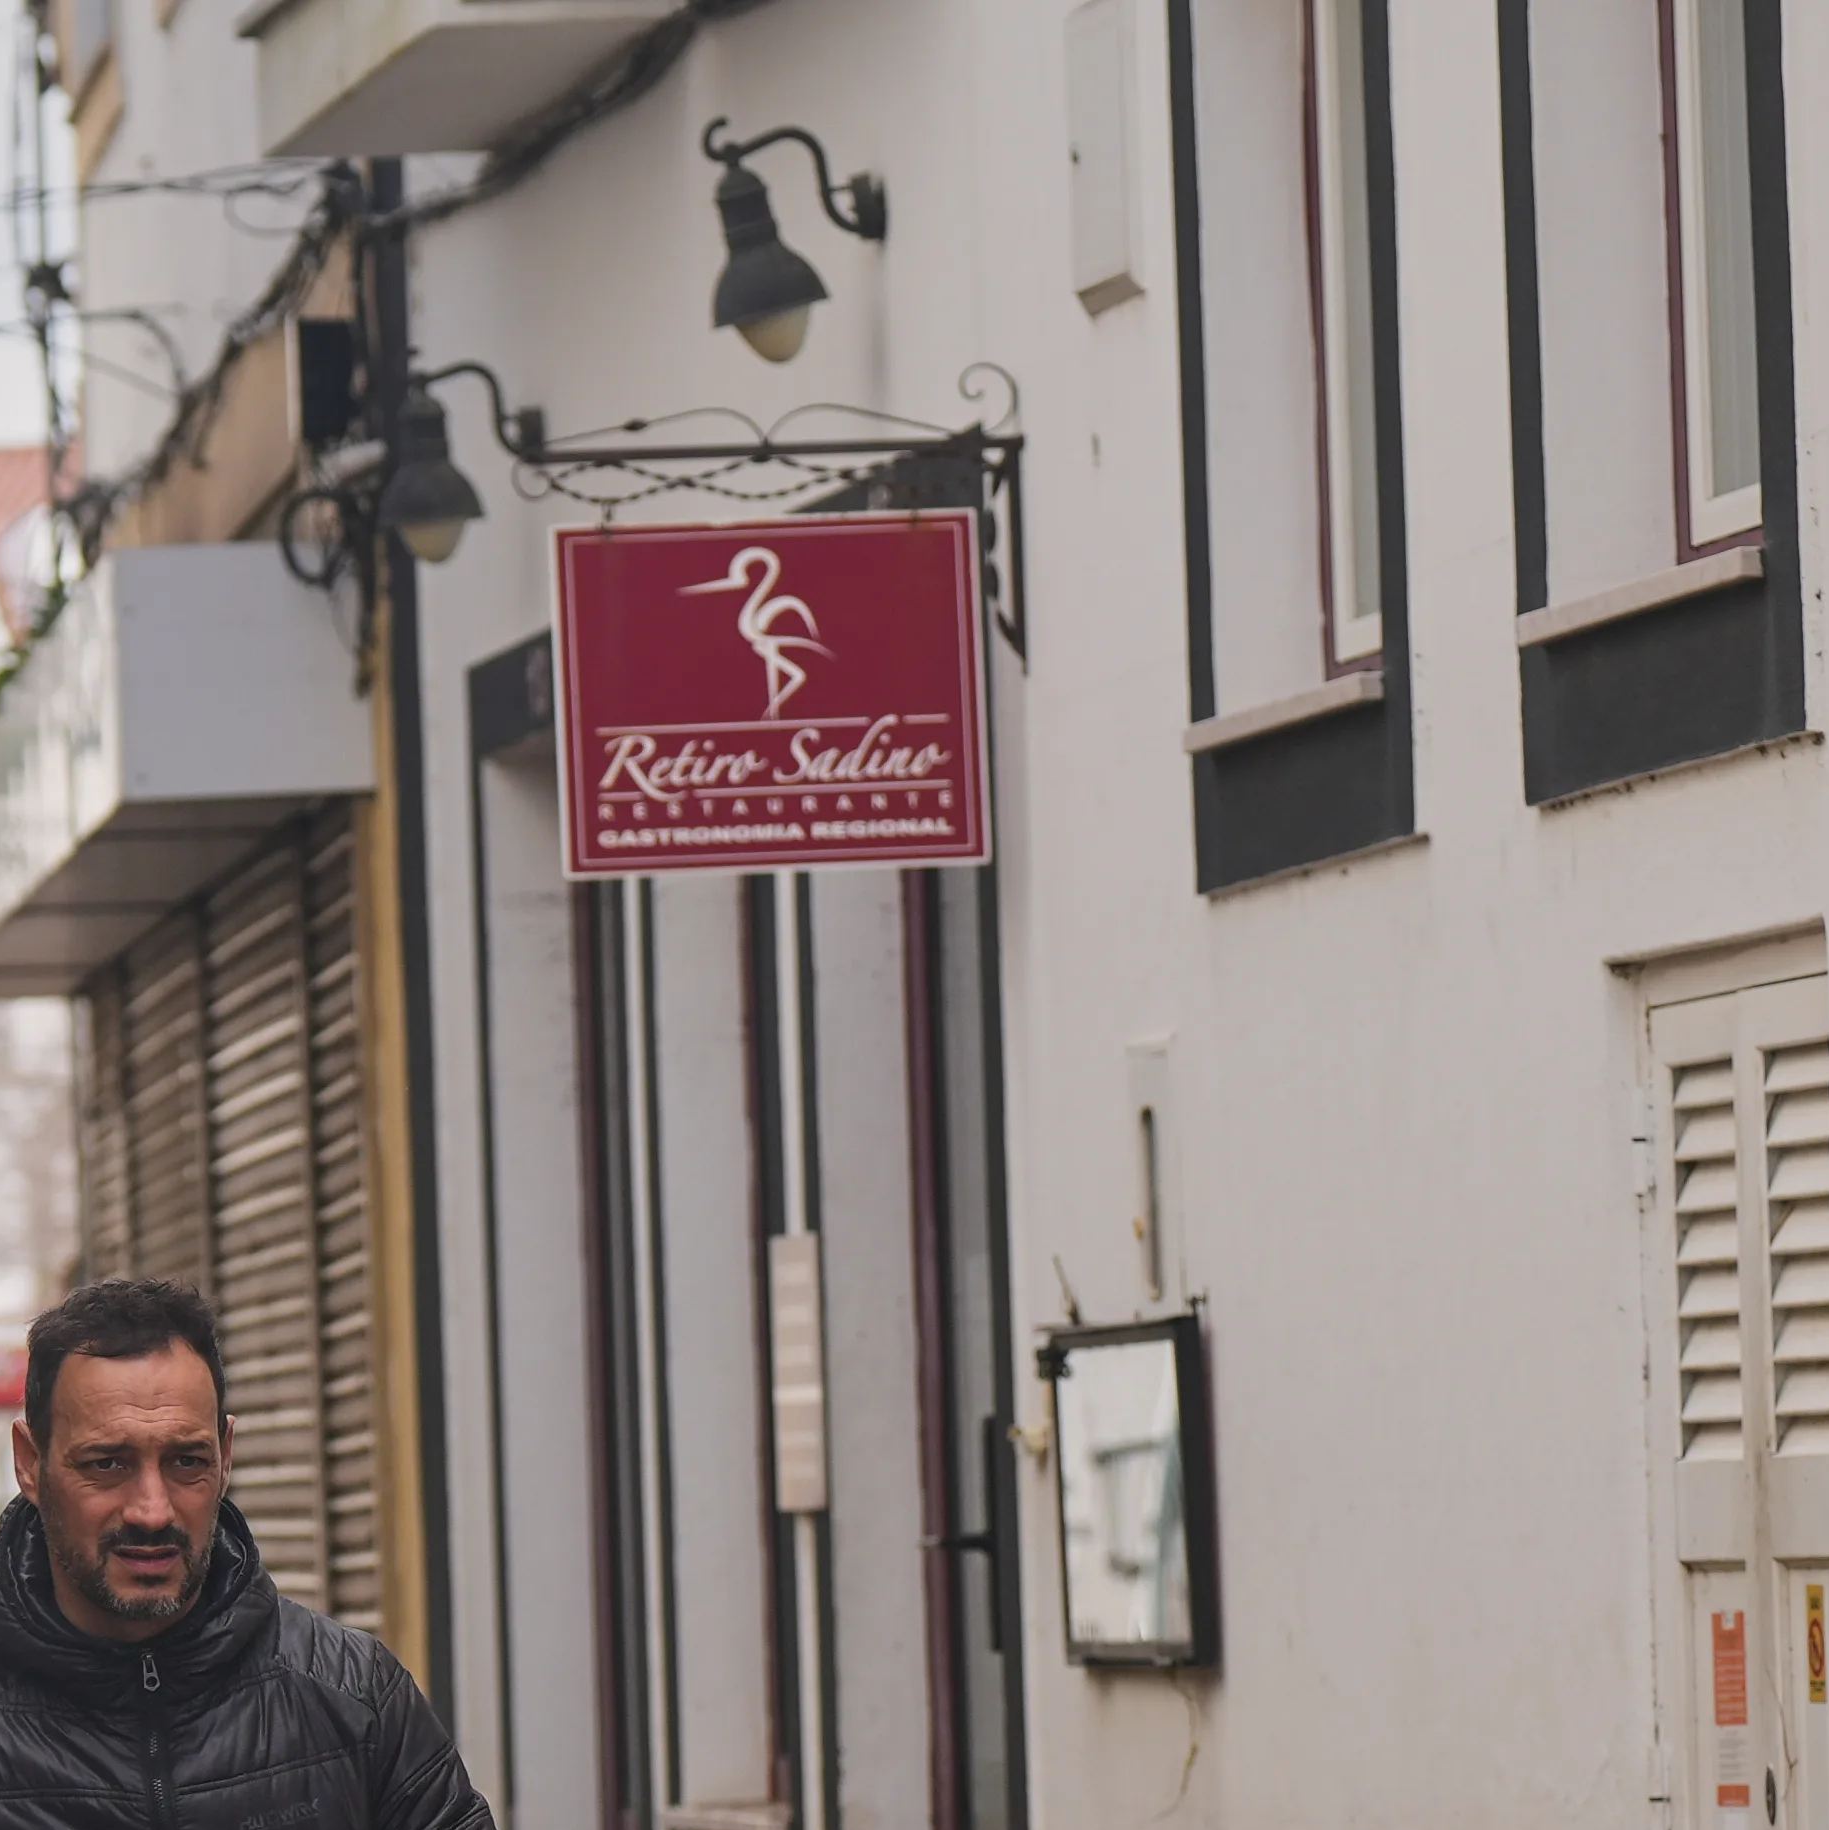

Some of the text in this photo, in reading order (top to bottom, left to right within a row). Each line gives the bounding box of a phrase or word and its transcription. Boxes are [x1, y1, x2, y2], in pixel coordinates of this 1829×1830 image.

[599, 714, 952, 802] Retiro Sadino
[597, 790, 954, 822] RESTAURANTE
[597, 816, 956, 849] GASTRONOMIA REGIONAL
